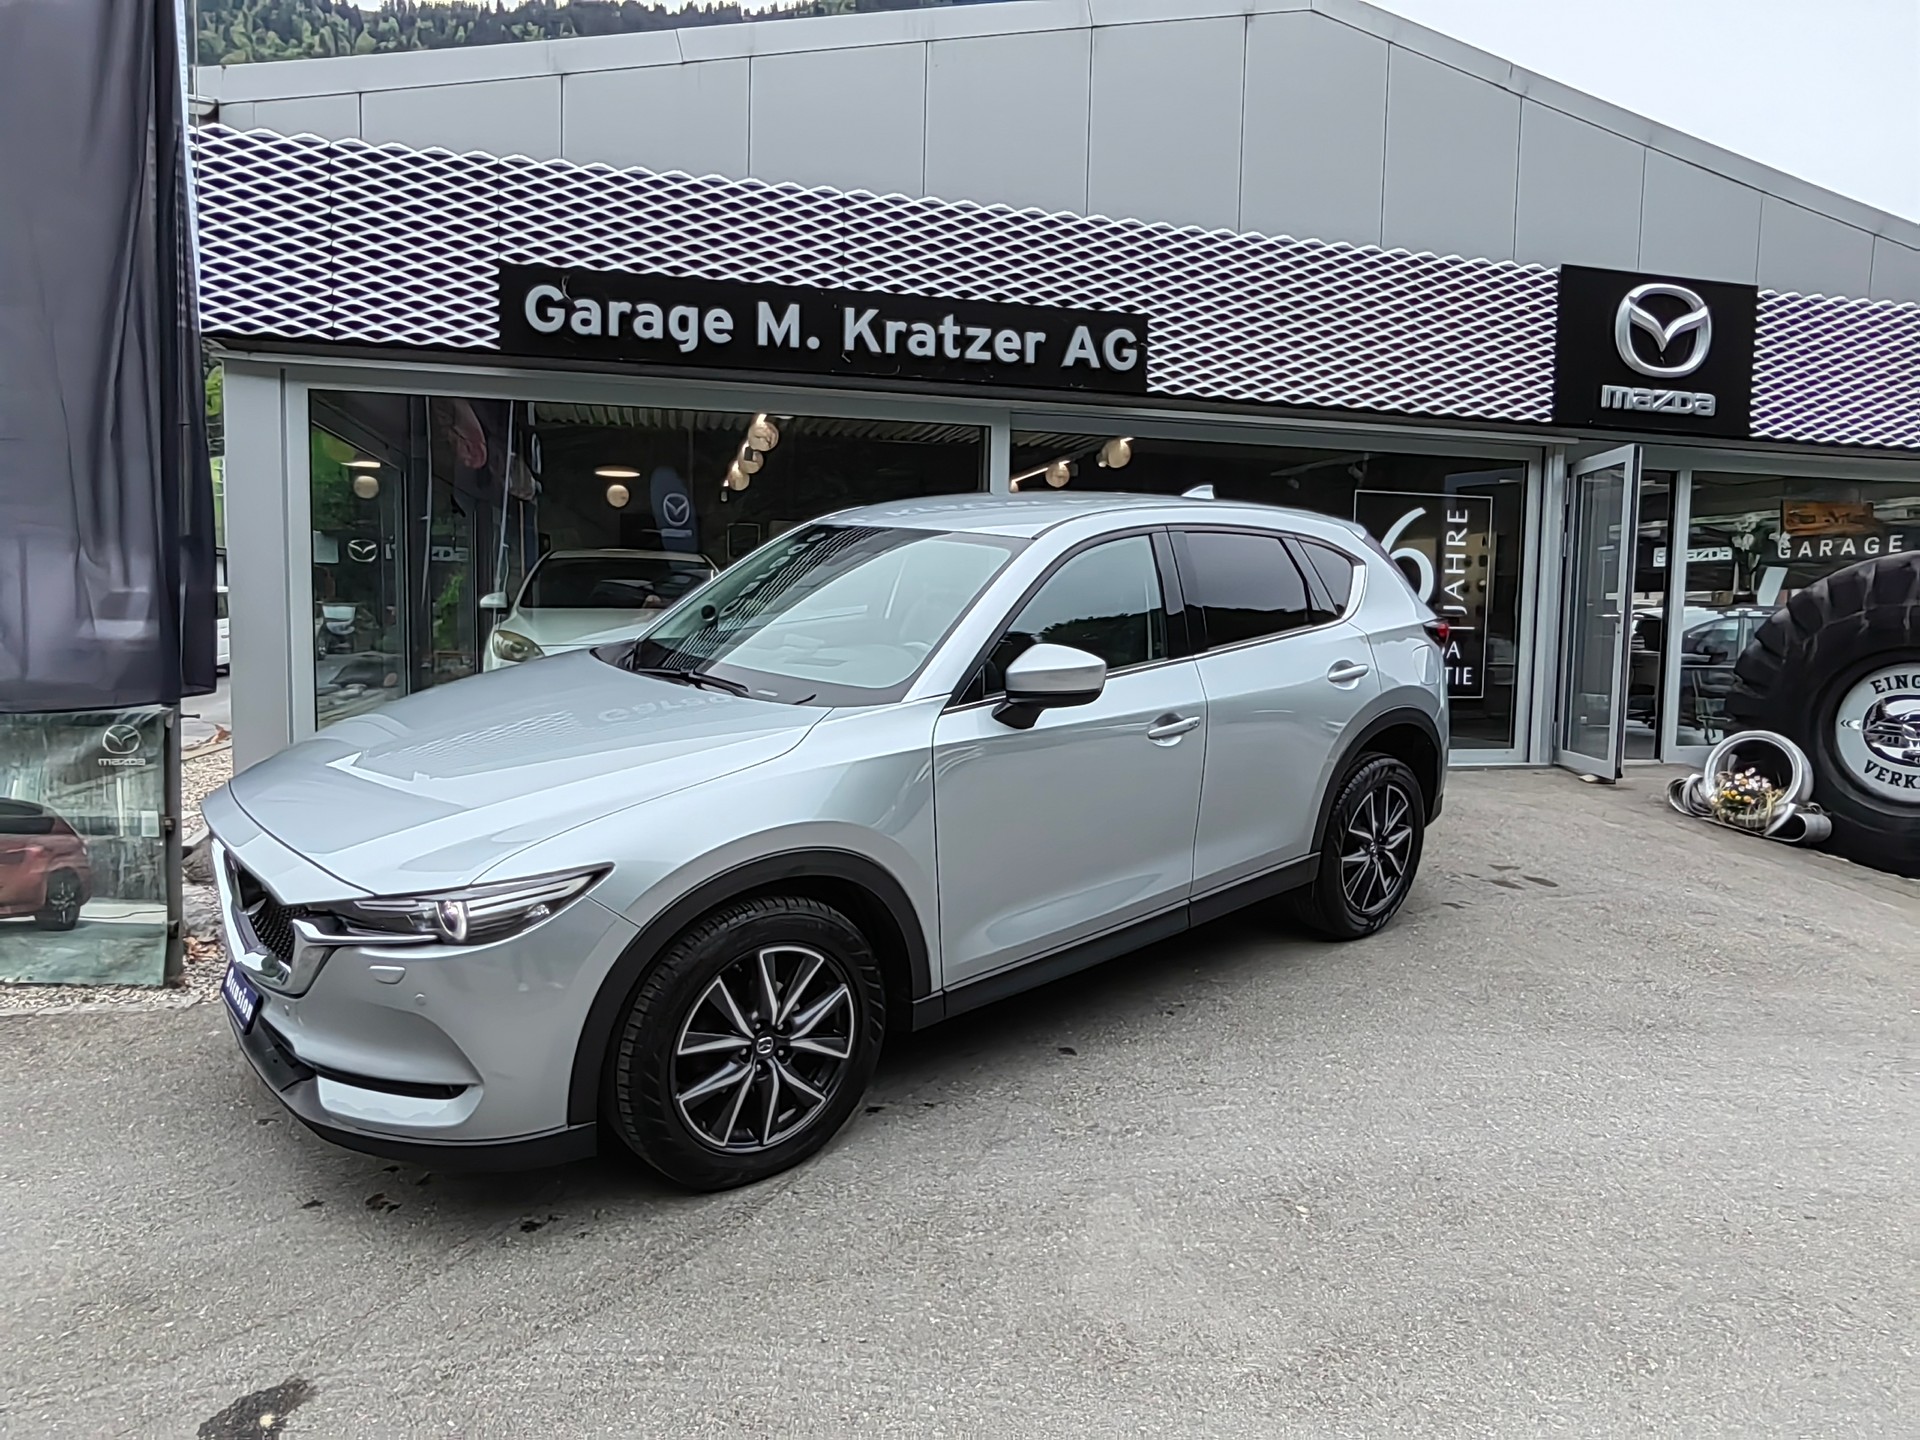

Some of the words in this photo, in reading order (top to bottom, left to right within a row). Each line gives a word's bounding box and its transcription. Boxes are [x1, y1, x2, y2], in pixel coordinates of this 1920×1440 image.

[525, 284, 734, 353] Garage
[757, 301, 820, 349] M.
[843, 307, 1047, 364] Kratzer
[1060, 325, 1138, 372] AG
[1442, 509, 1468, 615] JAHRE
[1778, 534, 1904, 559] GARAGE
